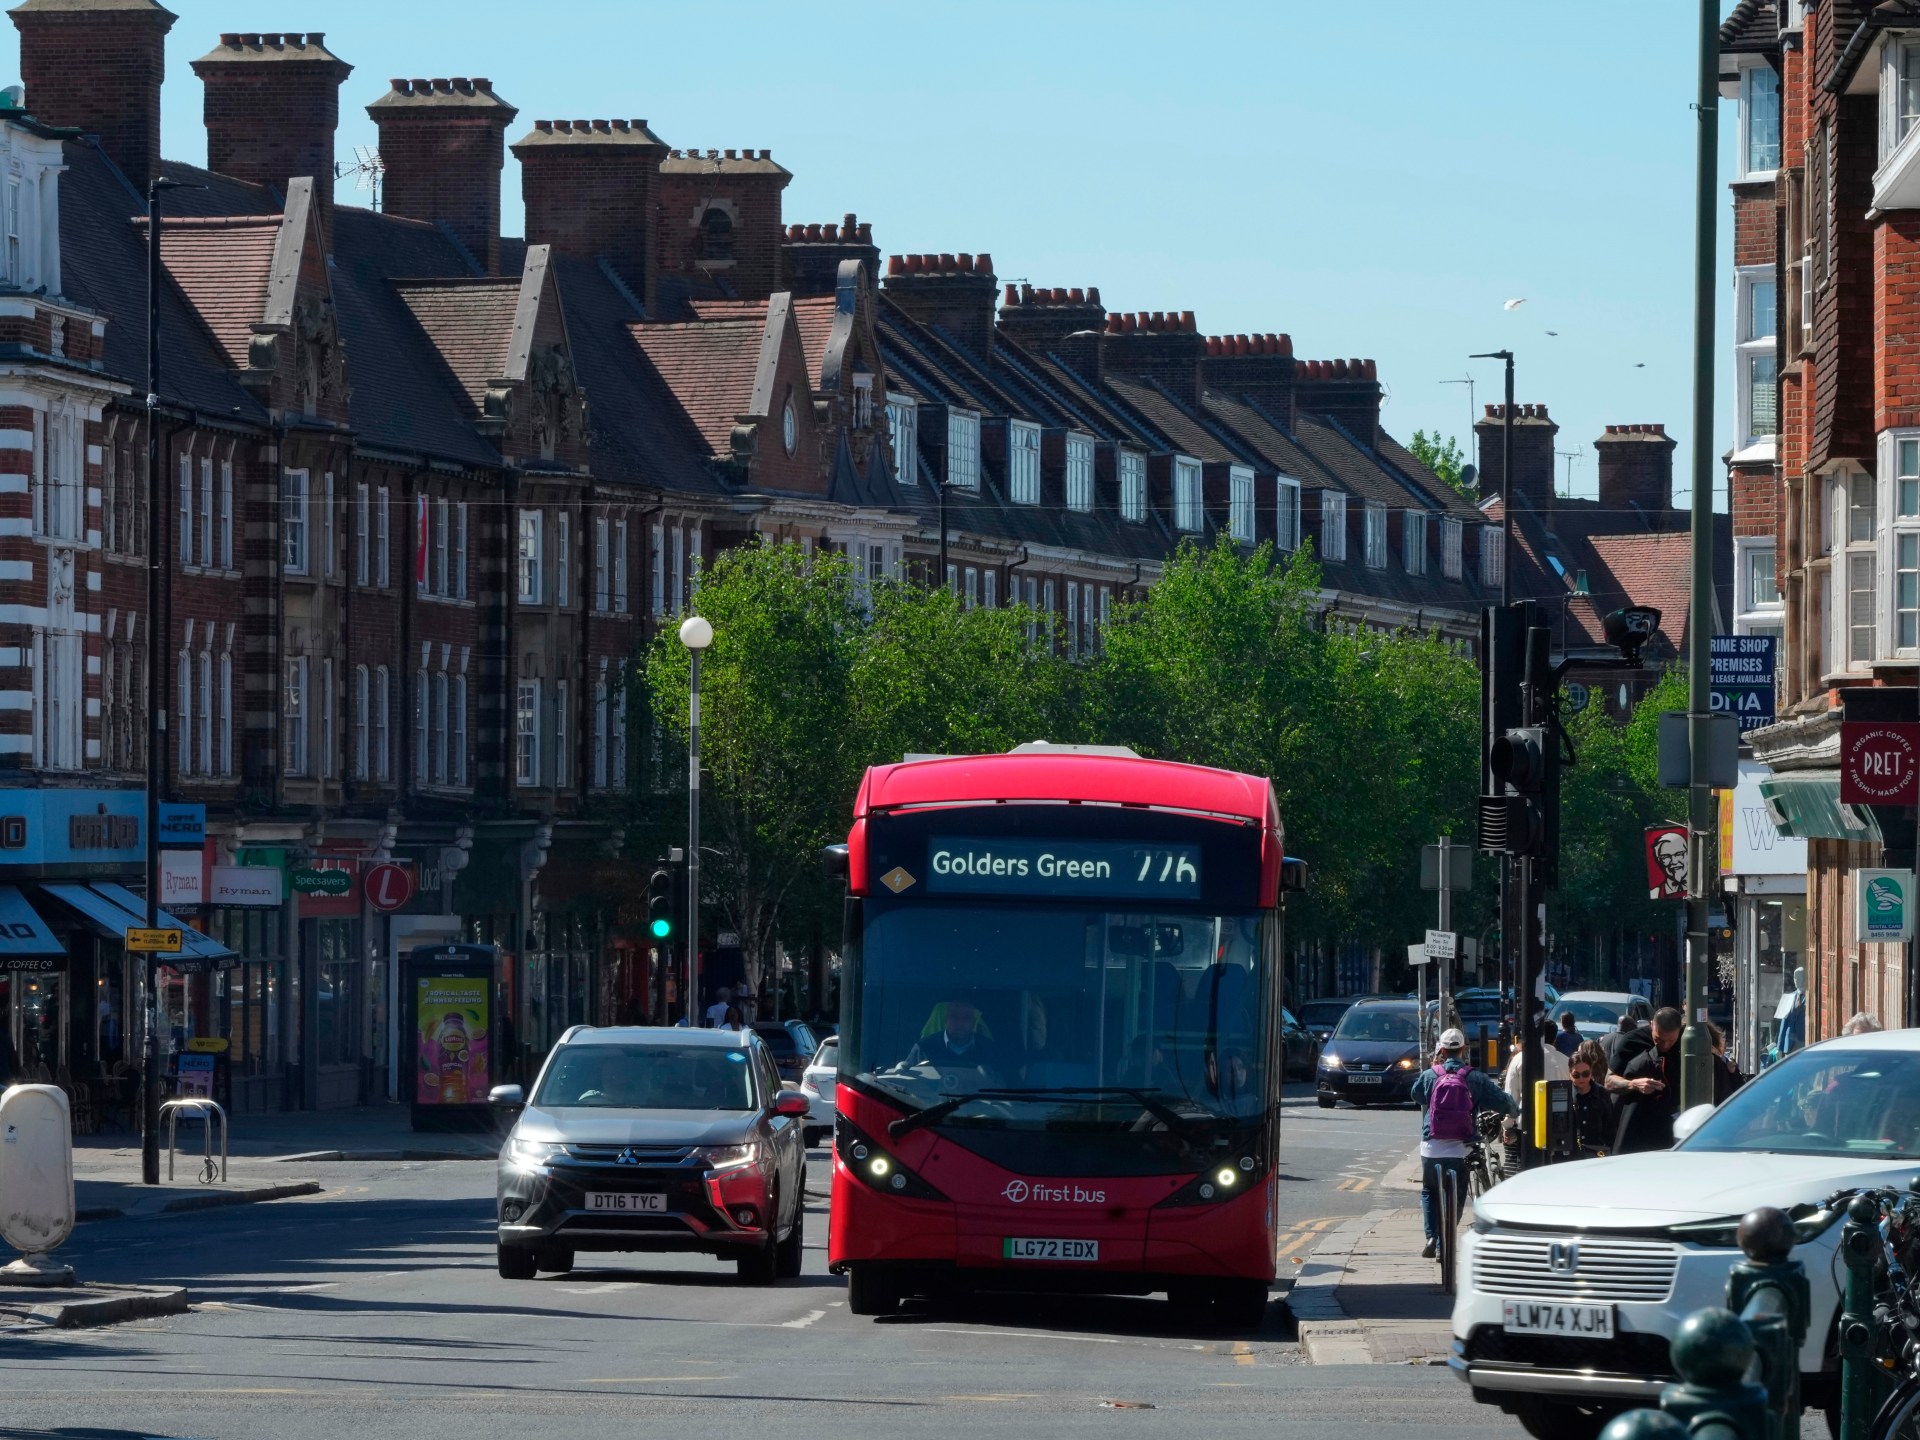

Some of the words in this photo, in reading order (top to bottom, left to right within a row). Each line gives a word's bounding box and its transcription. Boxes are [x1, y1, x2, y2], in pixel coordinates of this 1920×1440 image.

[1710, 639, 1736, 653] RIME
[1740, 639, 1769, 653] SHOP
[1716, 675, 1735, 683] LEASE
[1737, 675, 1771, 683] AVAILABLE
[1710, 692, 1761, 711] DMA
[1852, 730, 1885, 752] ORGANIC
[1886, 731, 1912, 753] COFFEE
[1864, 751, 1903, 776] PRET
[1850, 769, 1877, 796] FRESHLY
[1878, 786, 1900, 797] MADE
[1899, 769, 1914, 788] FOOD
[160, 823, 203, 833] NERO
[932, 850, 1029, 876] Golders
[1036, 853, 1111, 879] Green
[165, 871, 198, 895] Ryman
[295, 875, 346, 888] Specsavers
[420, 860, 440, 892] Local
[219, 886, 272, 896] Ryman
[378, 869, 397, 905] L
[7, 960, 40, 970] COFFEE
[594, 1194, 626, 1208] DT16
[631, 1195, 658, 1209] TYC
[1032, 1184, 1070, 1202] first
[1073, 1185, 1106, 1203] bus
[1014, 1240, 1057, 1257] LG72
[1062, 1241, 1095, 1258] EDX
[1571, 1307, 1607, 1333] XJH
